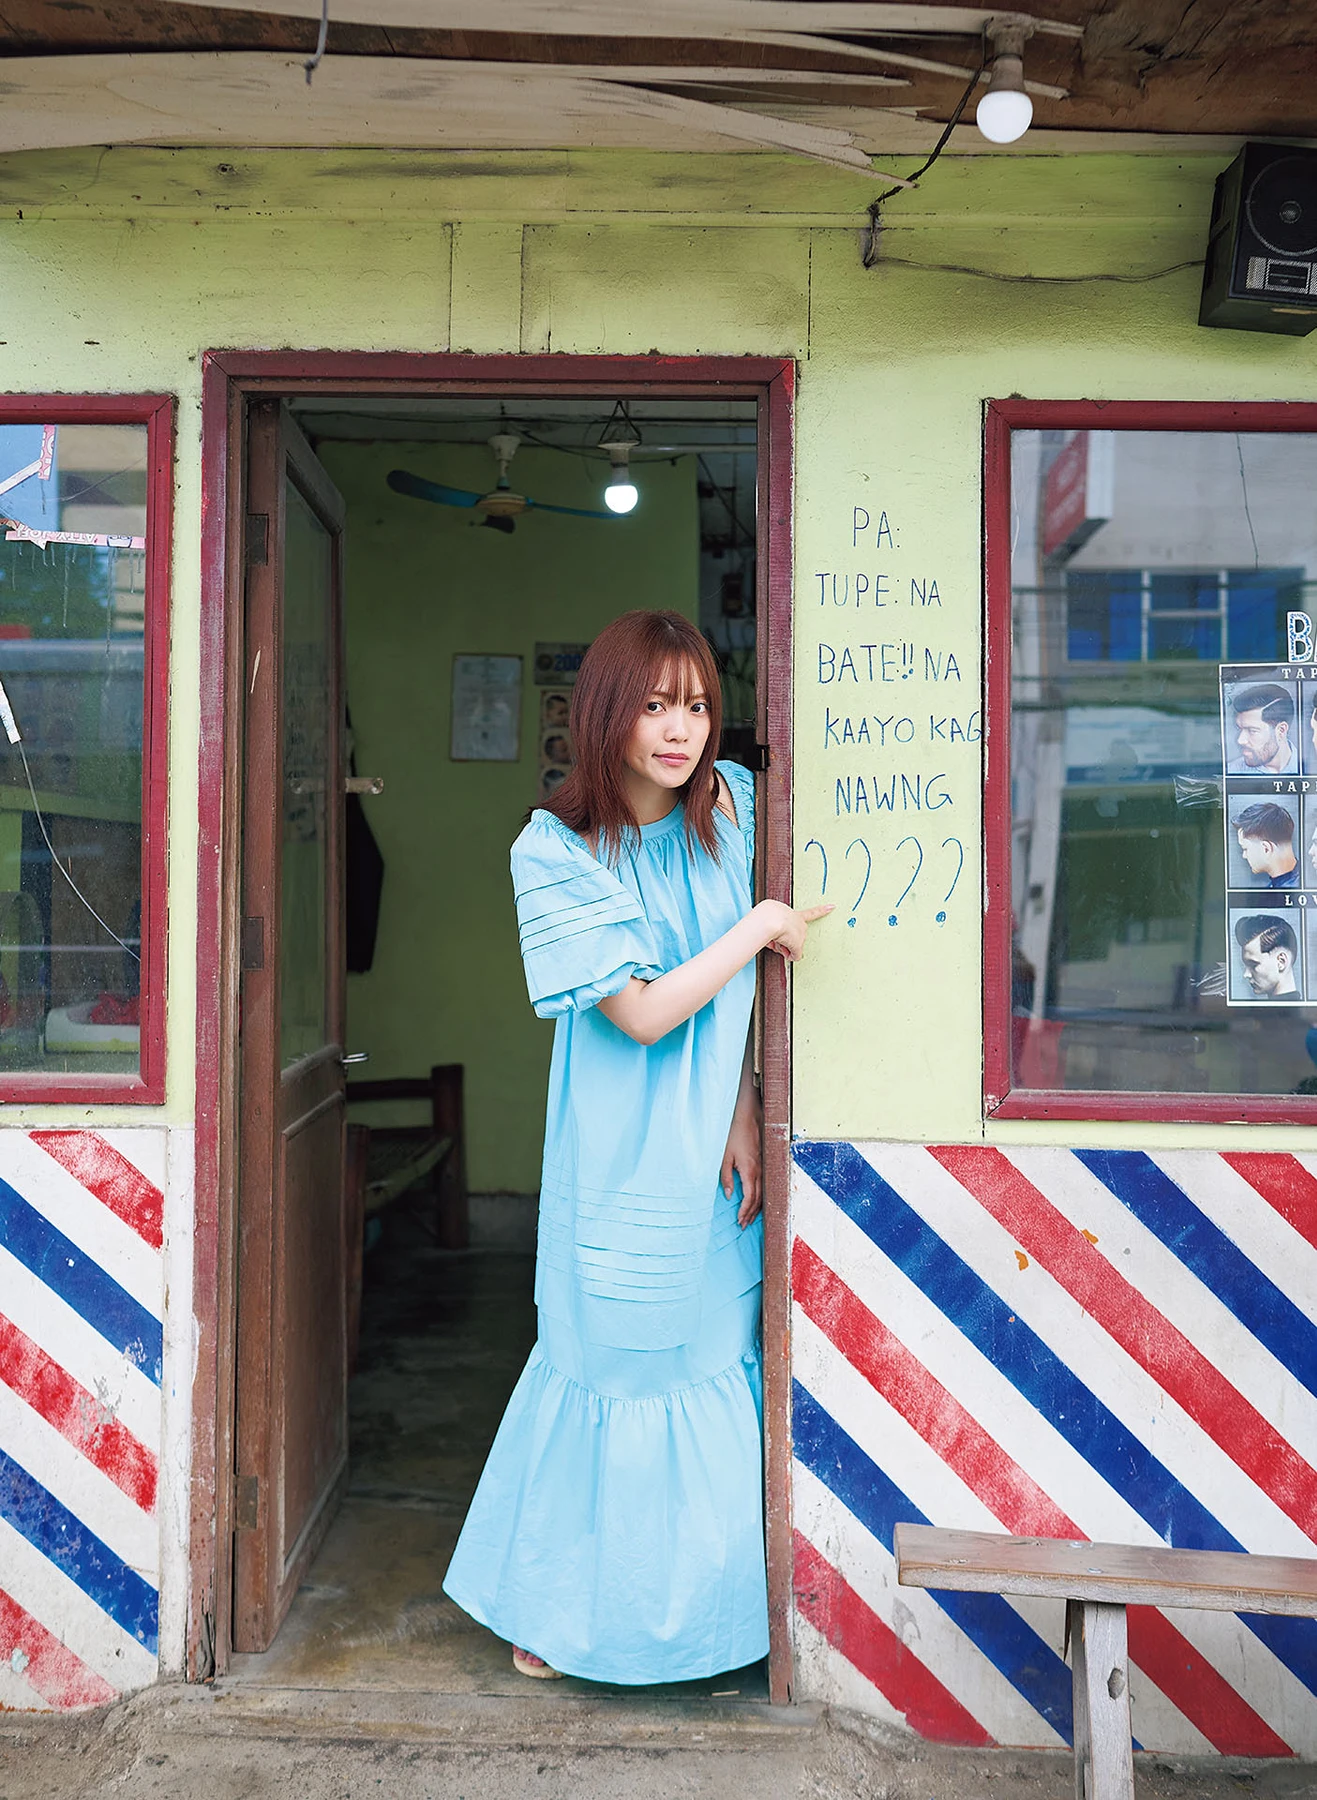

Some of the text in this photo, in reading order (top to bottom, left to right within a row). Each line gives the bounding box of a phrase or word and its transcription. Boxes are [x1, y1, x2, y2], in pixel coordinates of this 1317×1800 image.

[911, 578, 942, 607] NA
[1287, 611, 1317, 662] B
[925, 648, 961, 682] NA
[824, 707, 983, 750] KAAYO KAG
[836, 774, 953, 817] NAWNG
[1273, 781, 1317, 793] TAP
